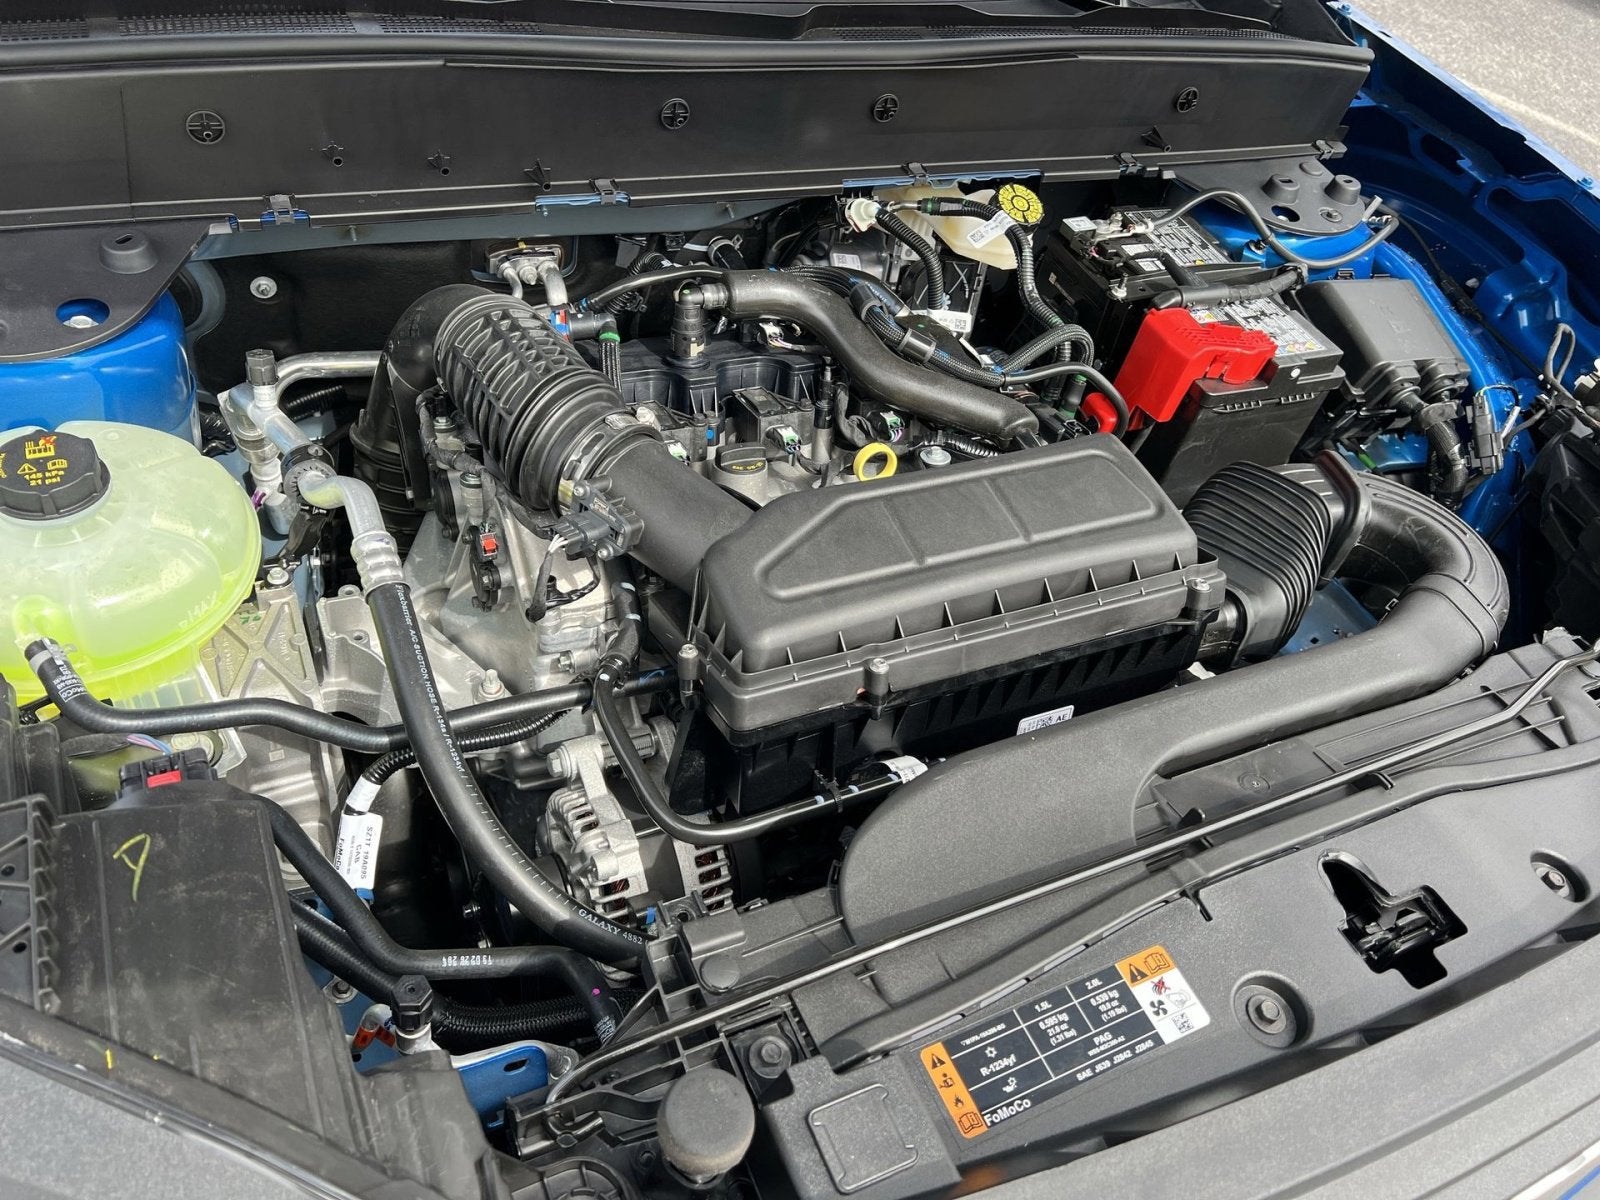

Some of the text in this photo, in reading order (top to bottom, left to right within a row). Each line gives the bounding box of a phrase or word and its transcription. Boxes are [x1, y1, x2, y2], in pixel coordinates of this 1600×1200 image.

[414, 644, 430, 680] SUCTION
[425, 681, 438, 704] HOSE
[578, 908, 621, 935] GALAXY
[1084, 978, 1103, 990] 2.0L
[1108, 989, 1120, 998] kg
[1034, 1000, 1052, 1012] 1.5L
[1057, 1012, 1070, 1022] kg
[1060, 1022, 1069, 1030] oz
[1093, 1032, 1113, 1046] PAG
[980, 1054, 1017, 1077] R-1234yf
[1076, 1040, 1154, 1081] SAE J639 J2842 J2845
[983, 1098, 1032, 1127] FoMoCo
